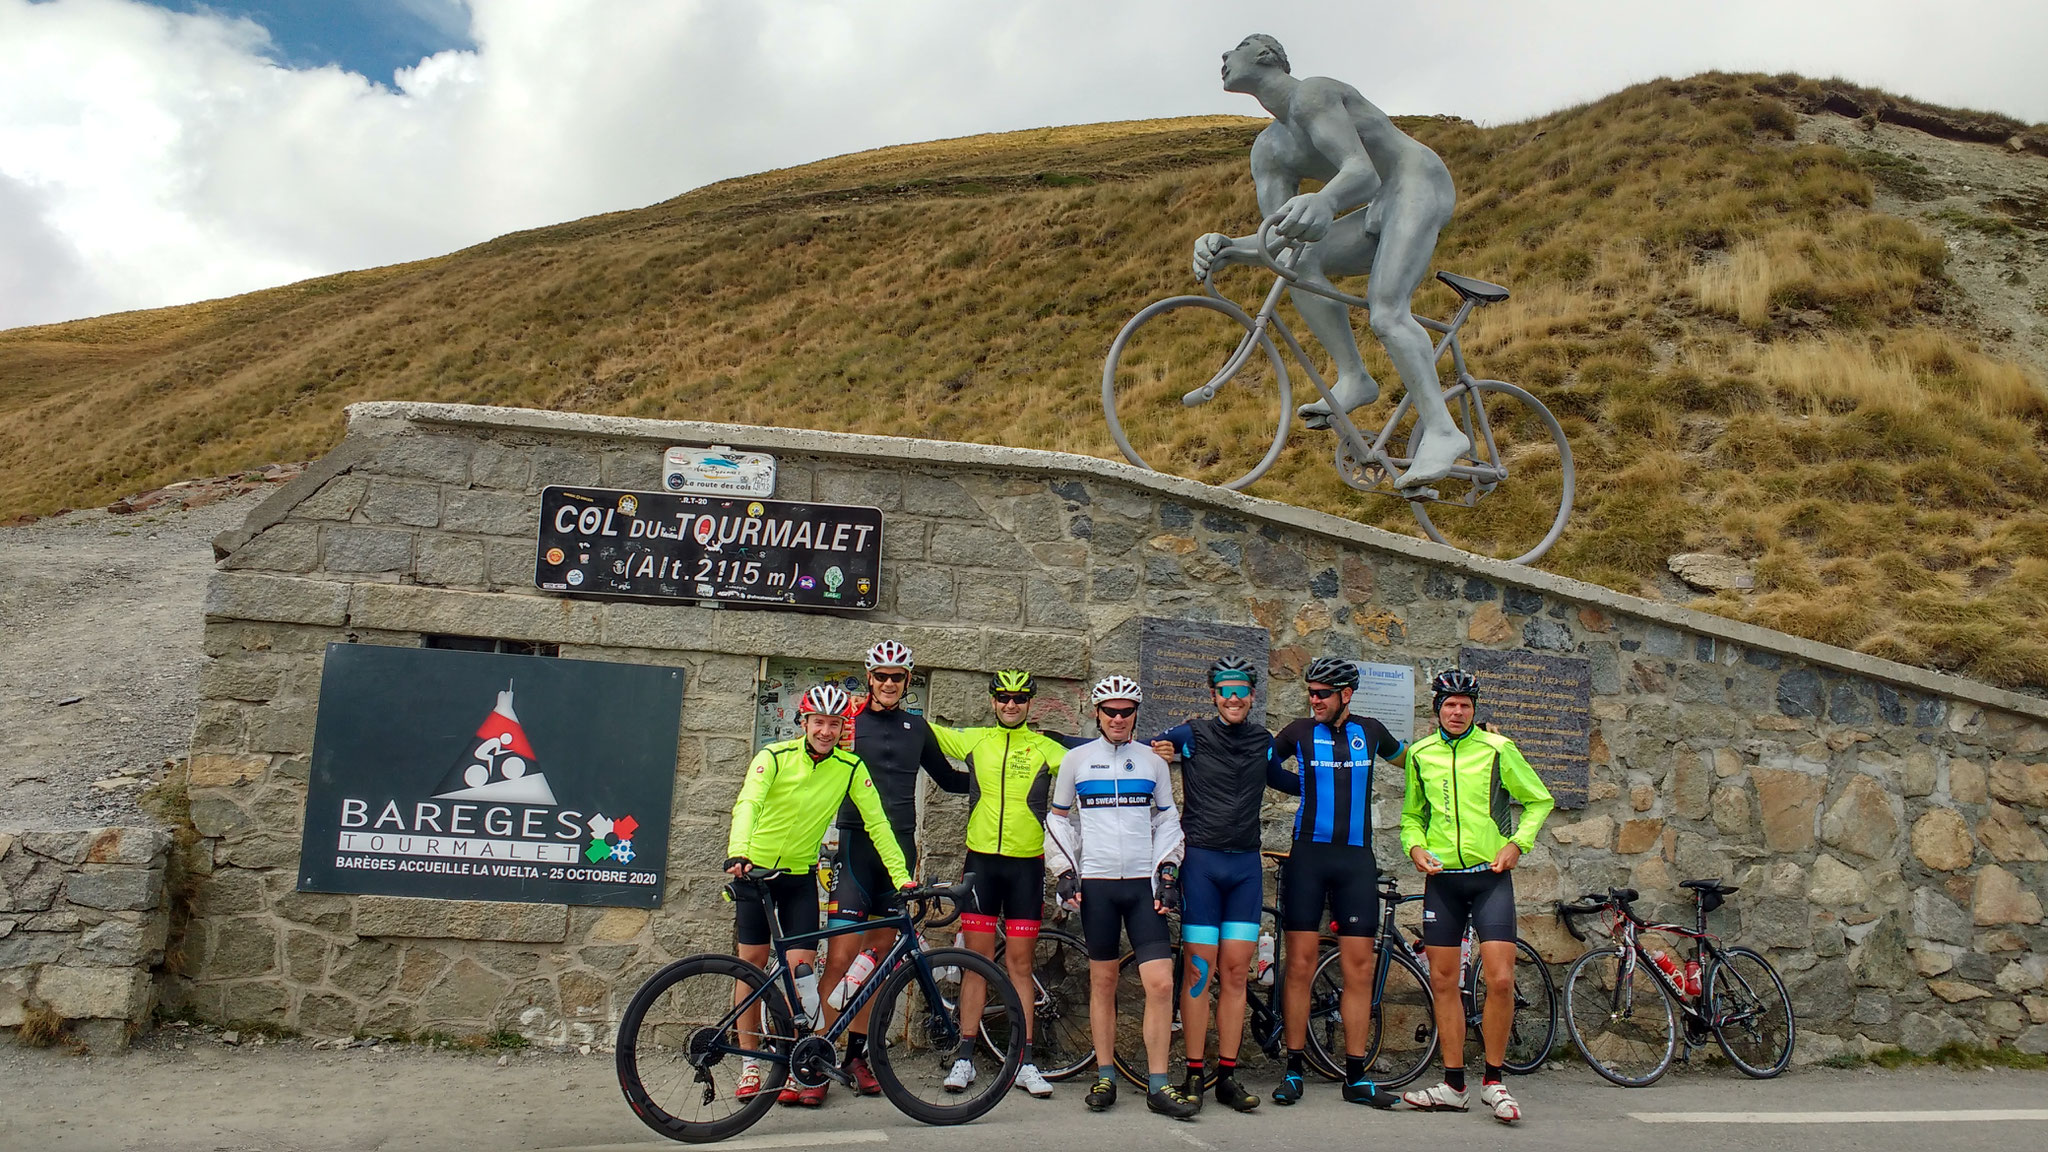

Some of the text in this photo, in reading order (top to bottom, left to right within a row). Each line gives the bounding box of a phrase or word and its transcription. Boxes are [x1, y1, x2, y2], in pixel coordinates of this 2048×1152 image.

[736, 483, 751, 491] cols
[554, 505, 874, 552] COL DU TOURMALET
[1368, 667, 1405, 679] Tourmalet
[340, 798, 583, 840] BAREGES
[343, 833, 577, 861] TOURMALET
[335, 855, 396, 872] BARÈGES
[398, 859, 470, 875] ACCUEILLE
[472, 863, 490, 876] LA
[492, 865, 539, 879] VUELTA
[550, 867, 564, 880] 25
[566, 868, 628, 883] OCTOBRE
[629, 872, 657, 885] 2020
